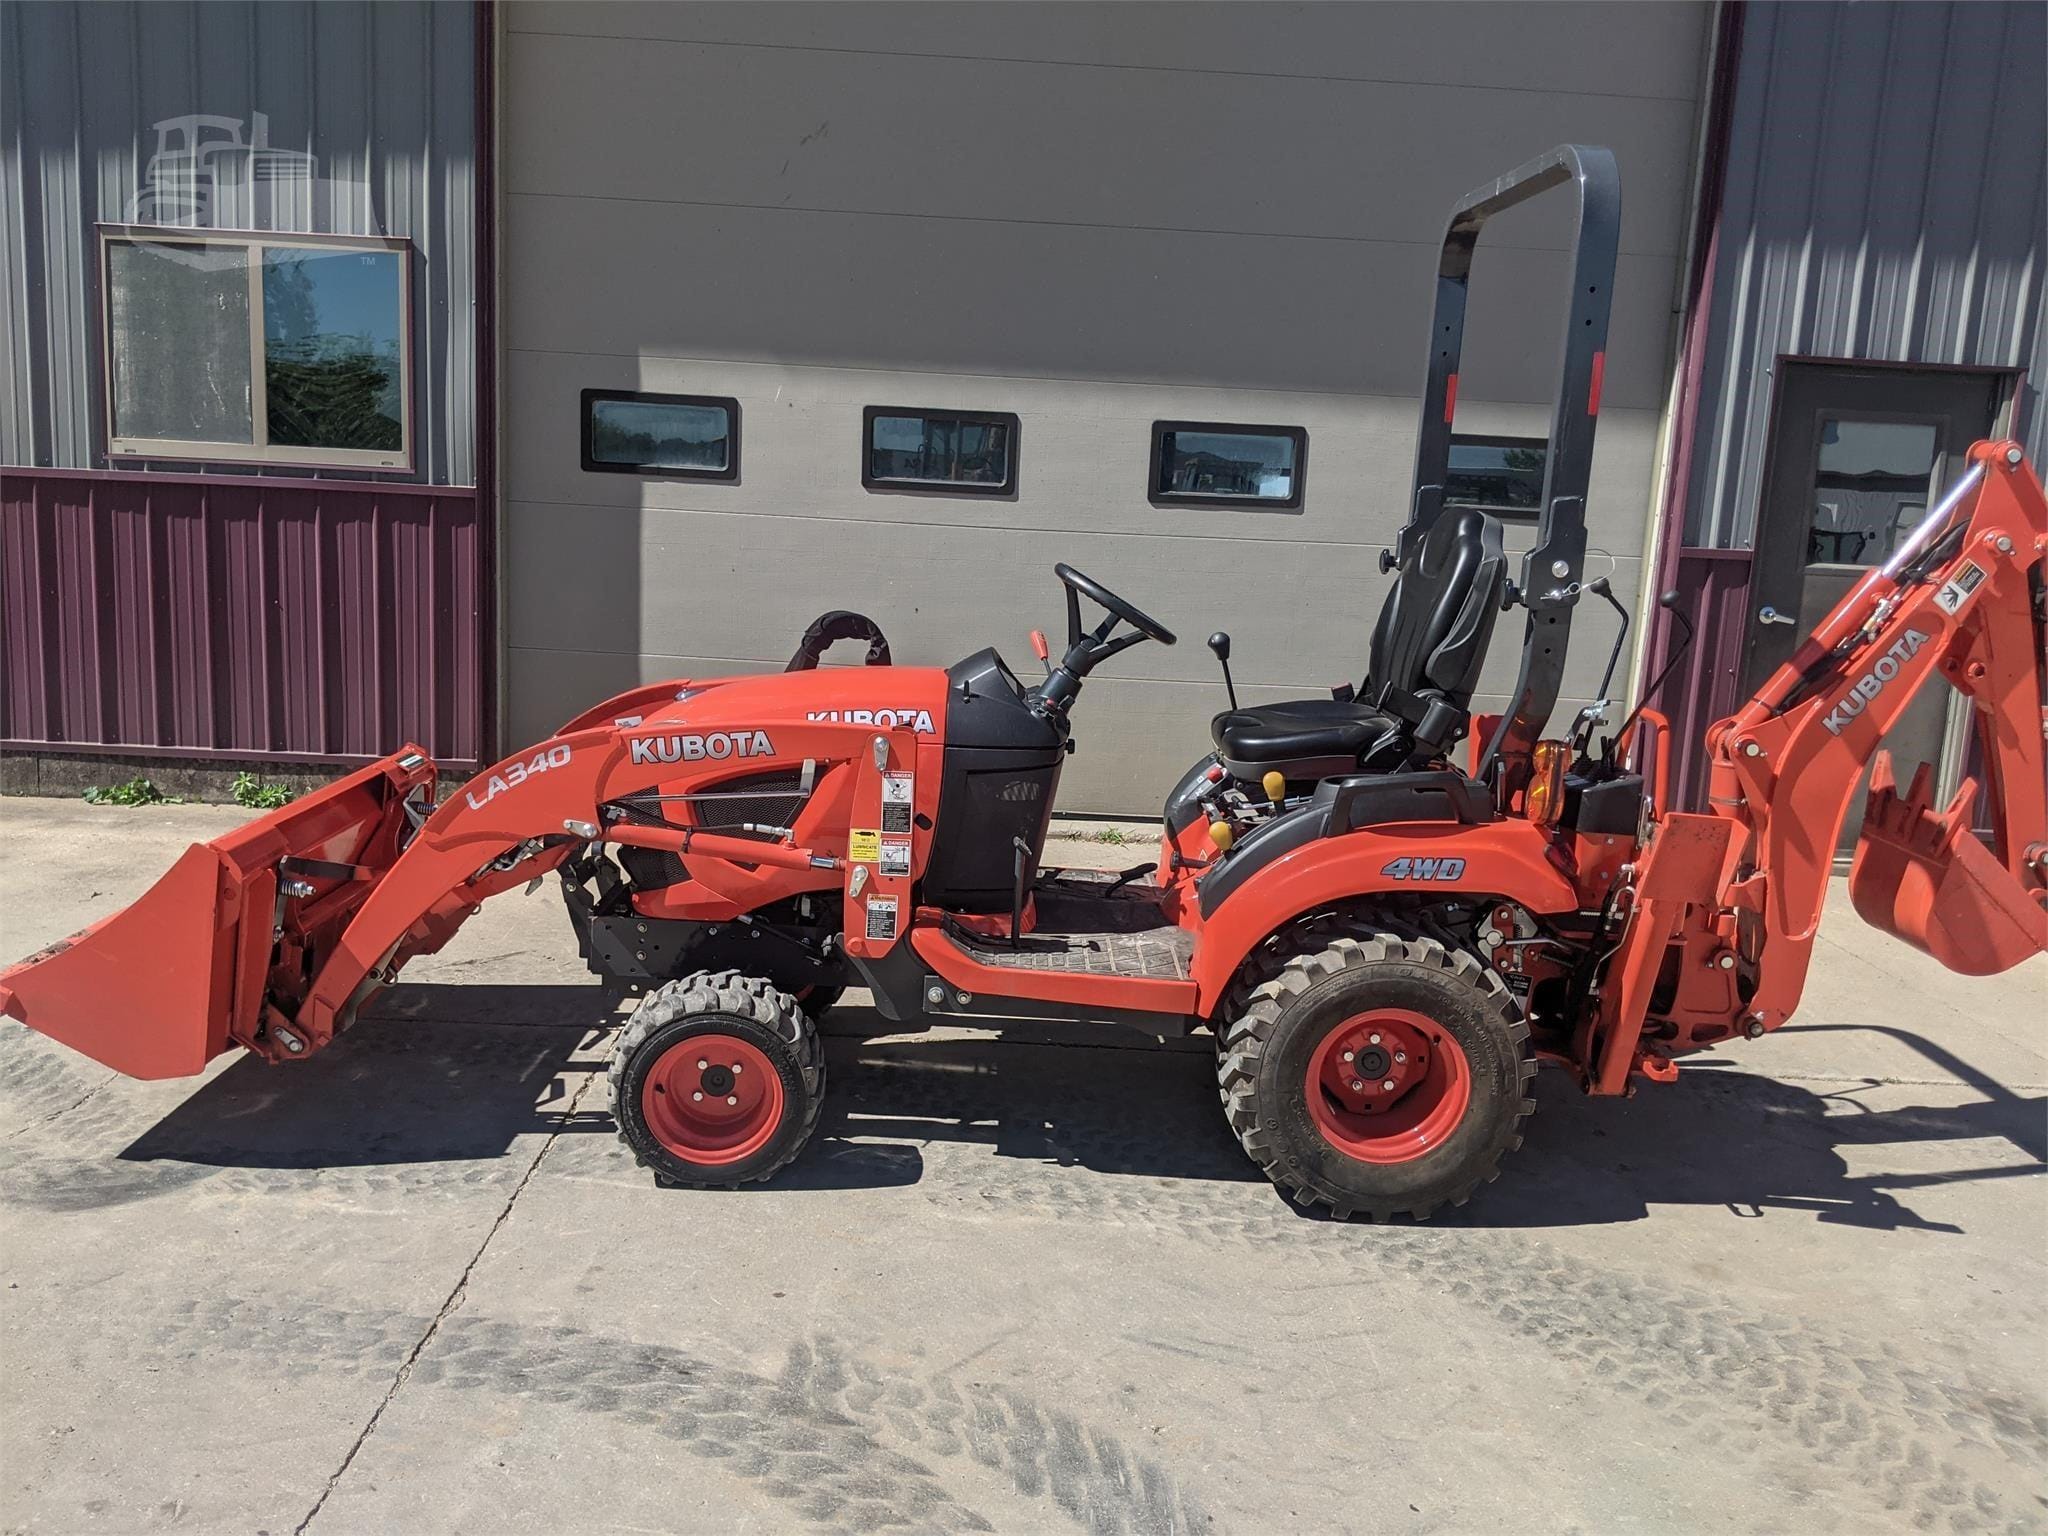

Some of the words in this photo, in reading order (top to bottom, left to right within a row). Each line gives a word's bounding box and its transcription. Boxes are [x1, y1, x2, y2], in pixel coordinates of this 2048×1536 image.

[1822, 628, 1930, 737] KUBOTA
[630, 729, 776, 764] KUBOTA
[465, 744, 571, 810] LA340
[1380, 856, 1467, 881] 4WD
